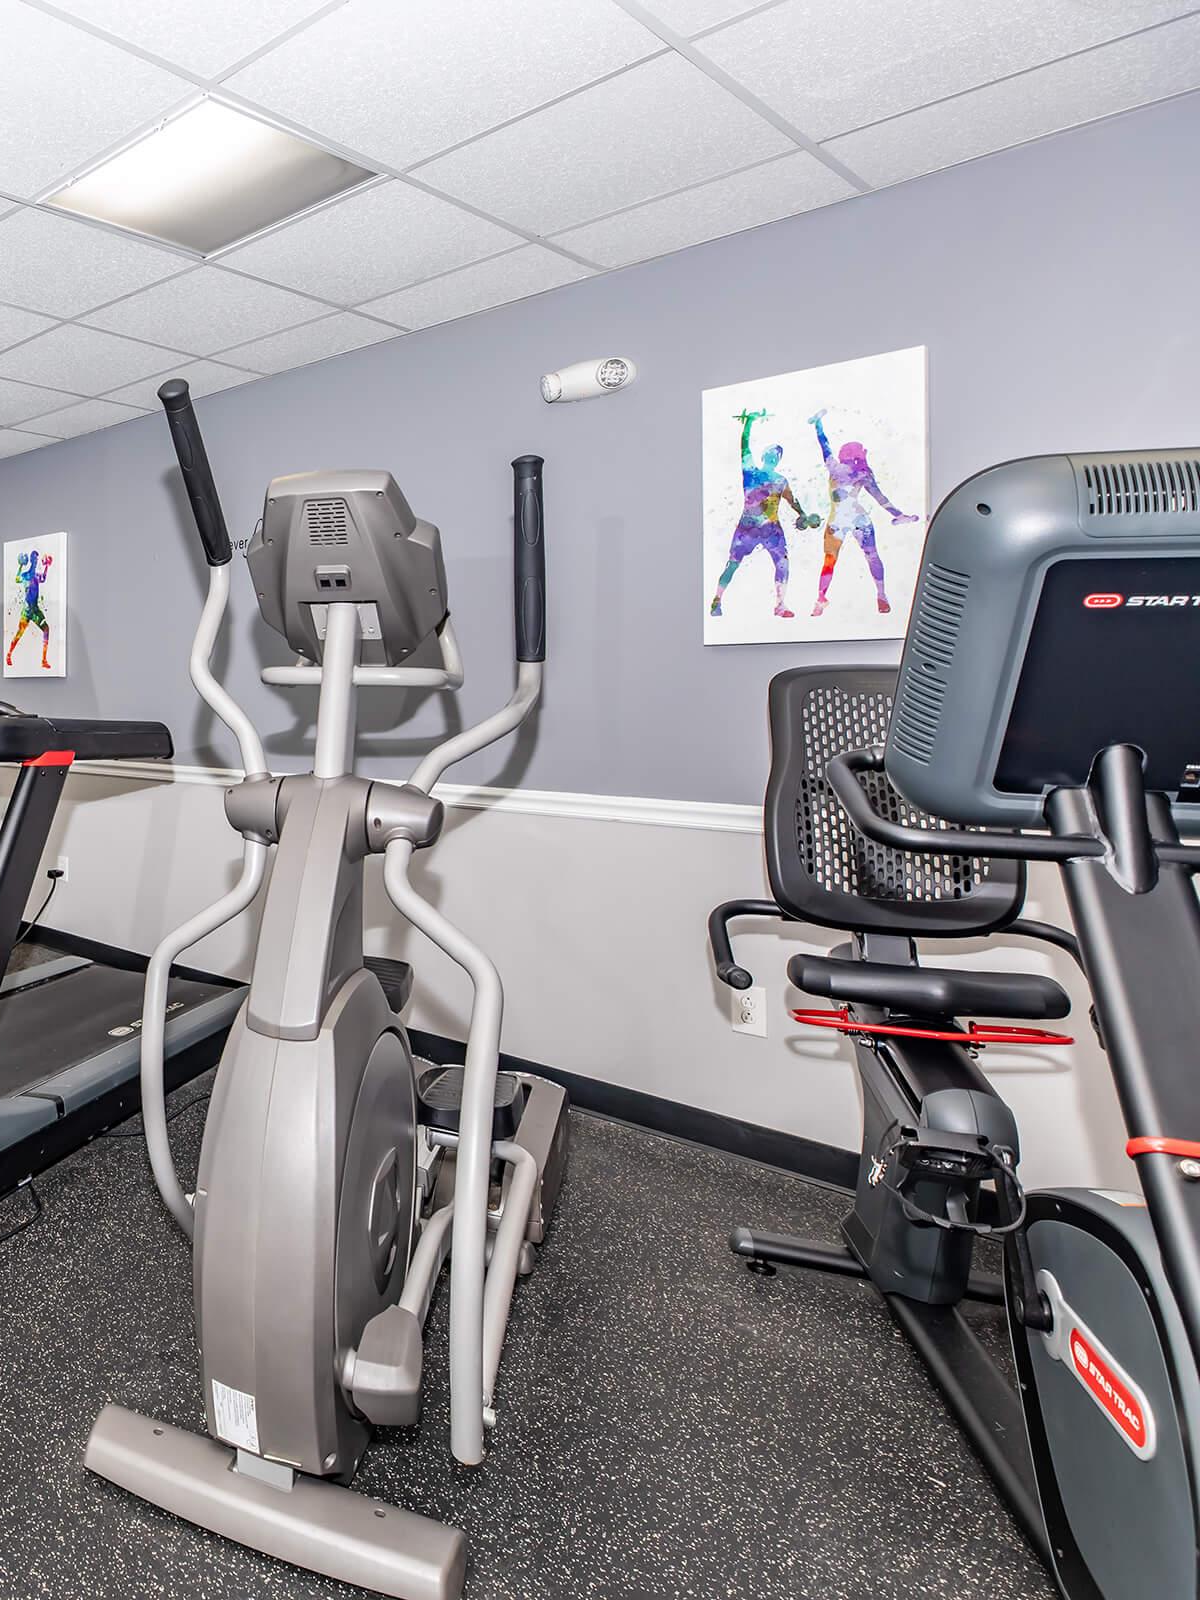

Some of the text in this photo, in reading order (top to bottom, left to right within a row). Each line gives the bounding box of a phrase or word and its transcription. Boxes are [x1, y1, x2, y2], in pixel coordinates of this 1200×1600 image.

[1126, 596, 1189, 606] STAR
[1089, 1362, 1141, 1431] STAR TRAC
